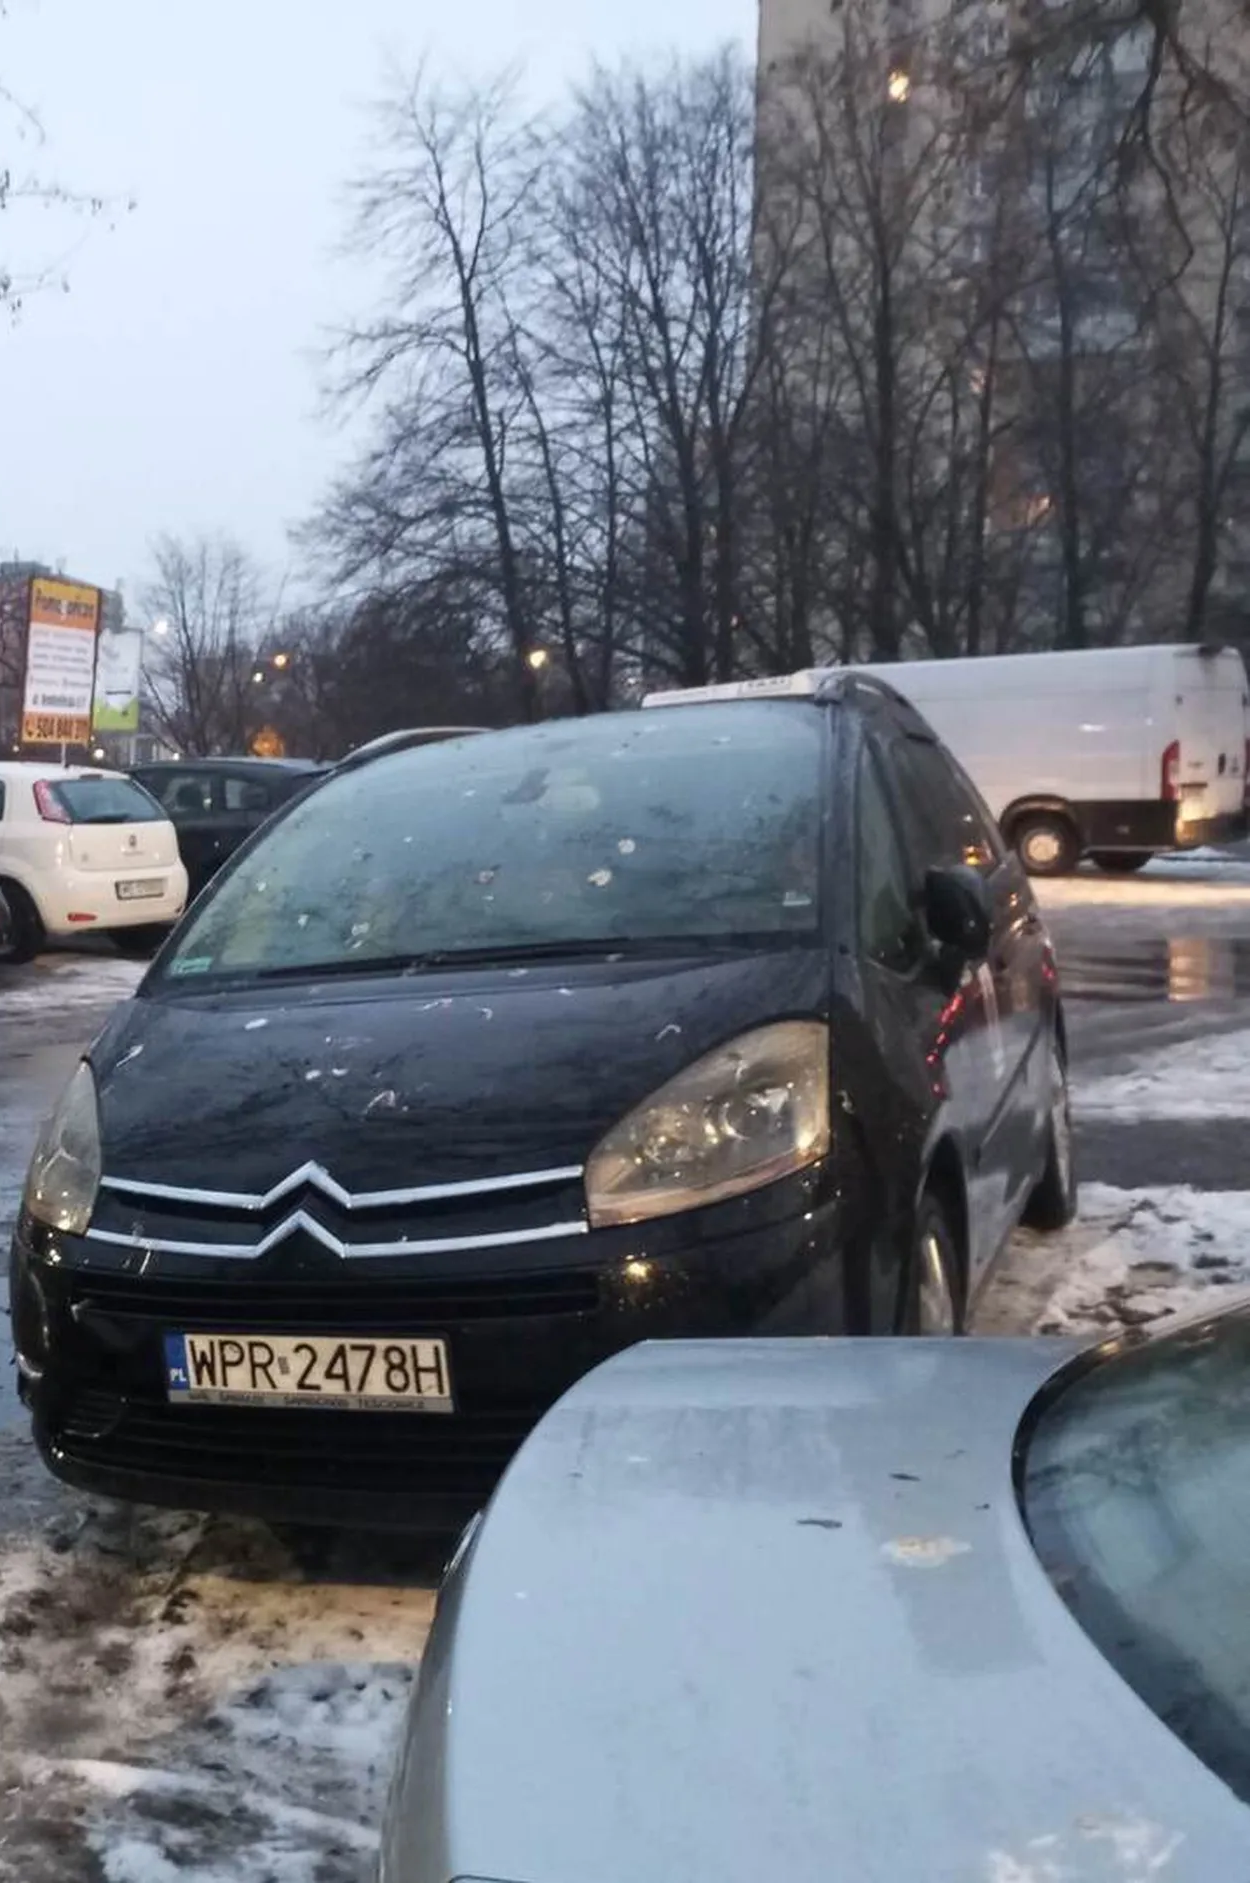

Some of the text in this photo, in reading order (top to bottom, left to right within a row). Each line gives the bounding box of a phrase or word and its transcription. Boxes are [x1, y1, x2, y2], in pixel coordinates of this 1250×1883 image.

[169, 1367, 188, 1383] PL
[188, 1339, 445, 1396] WPR 2478H
